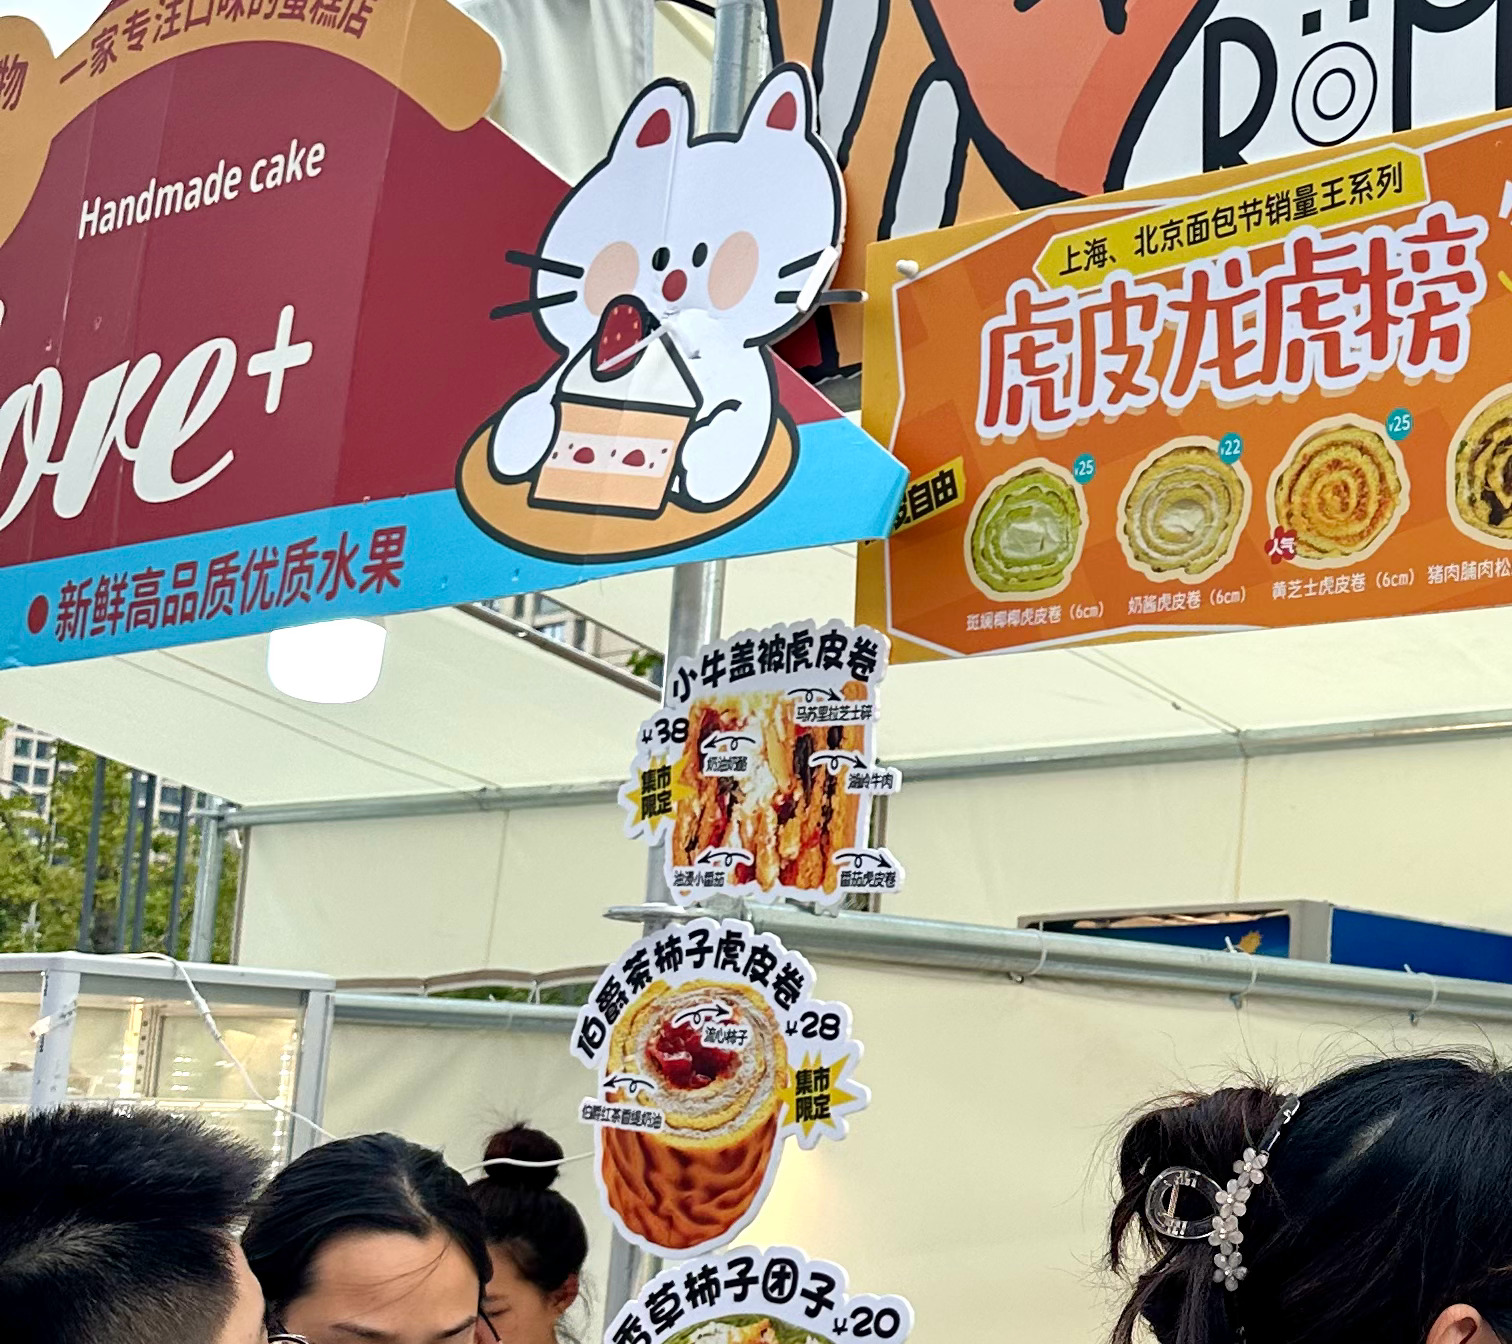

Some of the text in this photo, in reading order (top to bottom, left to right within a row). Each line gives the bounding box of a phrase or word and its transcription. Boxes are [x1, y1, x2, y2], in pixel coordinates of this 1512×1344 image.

[78, 139, 326, 240] Handmade cake
[1058, 162, 1405, 277] 上海、北京面包节销量王系列
[980, 211, 1481, 428] 虎皮龙虎榜
[1268, 537, 1295, 555] 人气
[55, 525, 407, 644] 新鲜高品质优质水果
[672, 629, 878, 703] 小牛盖被虎皮卷
[640, 764, 672, 793] 集市
[641, 791, 672, 820] 限定
[577, 928, 805, 1060] 伯爵茶柿子虎皮卷
[795, 1067, 830, 1096] 集市
[795, 1095, 831, 1123] 限定
